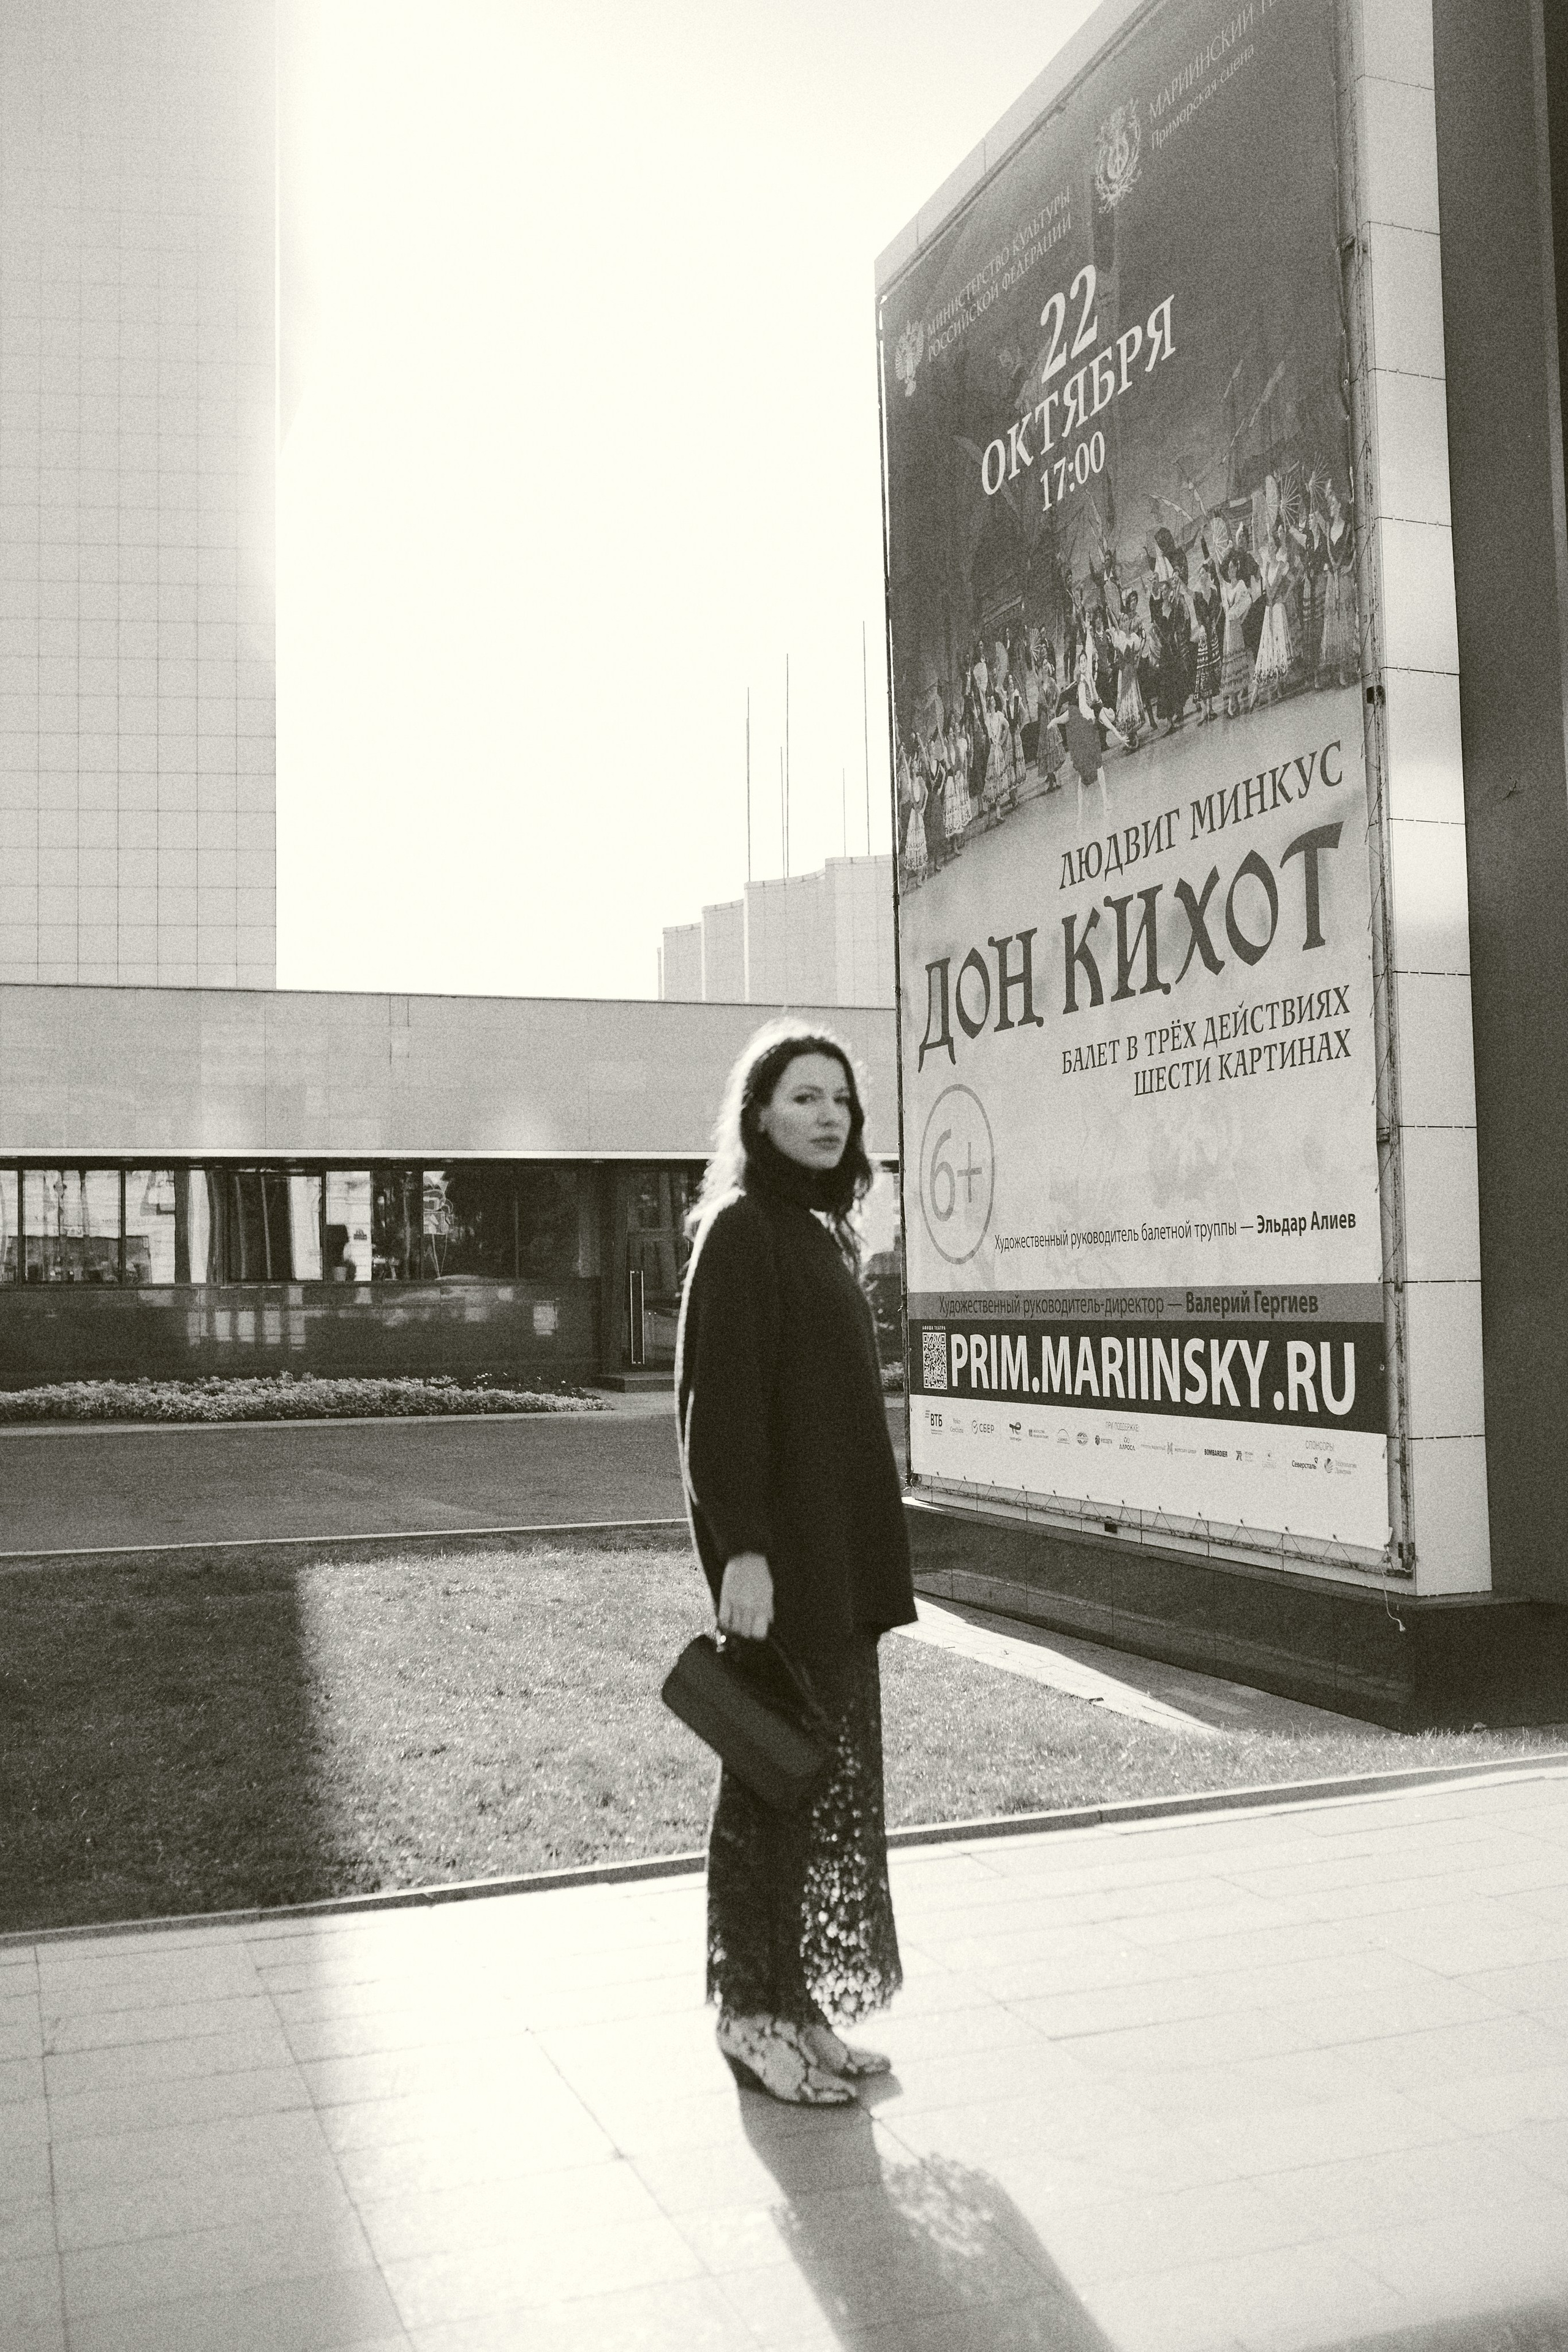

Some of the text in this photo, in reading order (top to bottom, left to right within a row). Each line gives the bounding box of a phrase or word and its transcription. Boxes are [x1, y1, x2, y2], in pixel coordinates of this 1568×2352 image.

[1152, 44, 1254, 149] Приморская сцена
[927, 186, 1070, 339] МИНИСТЕРСТВО КУЛЬТУРЫ
[929, 213, 1071, 363] РОССИЙСКОЙ ФЕДЕРАЦИИ
[1041, 264, 1098, 385] 22
[981, 294, 1177, 496] ОКТЯБРЯ
[1040, 431, 1106, 512] 17:00
[1059, 740, 1344, 890] ЛЮДВИГ МИНКУС
[918, 821, 1344, 1074] ДОН КИХОТ
[1061, 984, 1351, 1075] БАЛЕТ В ТРЁХ ДЕЙСТВИЯХ
[1134, 1028, 1352, 1096] ШЕСТИ КАРТИНАХ
[929, 1128, 983, 1222] 6+
[994, 1229, 1069, 1254] Художественный
[1071, 1228, 1139, 1250] руководитель
[1140, 1220, 1192, 1242] балетной
[1194, 1222, 1237, 1242] труппы
[1256, 1215, 1307, 1236] Эльдар
[1310, 1210, 1357, 1231] Алиев
[939, 1295, 1020, 1318] Художественный
[1023, 1295, 1164, 1318] руководитель-директор
[1185, 1290, 1251, 1319] Валерий
[1253, 1290, 1319, 1319] Гергиев
[951, 1333, 1356, 1415] PRIM.MARIINSKY.RU
[930, 1413, 943, 1427] ВТБ
[979, 1423, 995, 1434] СБЕР
[1292, 1460, 1317, 1470] Северсталь
